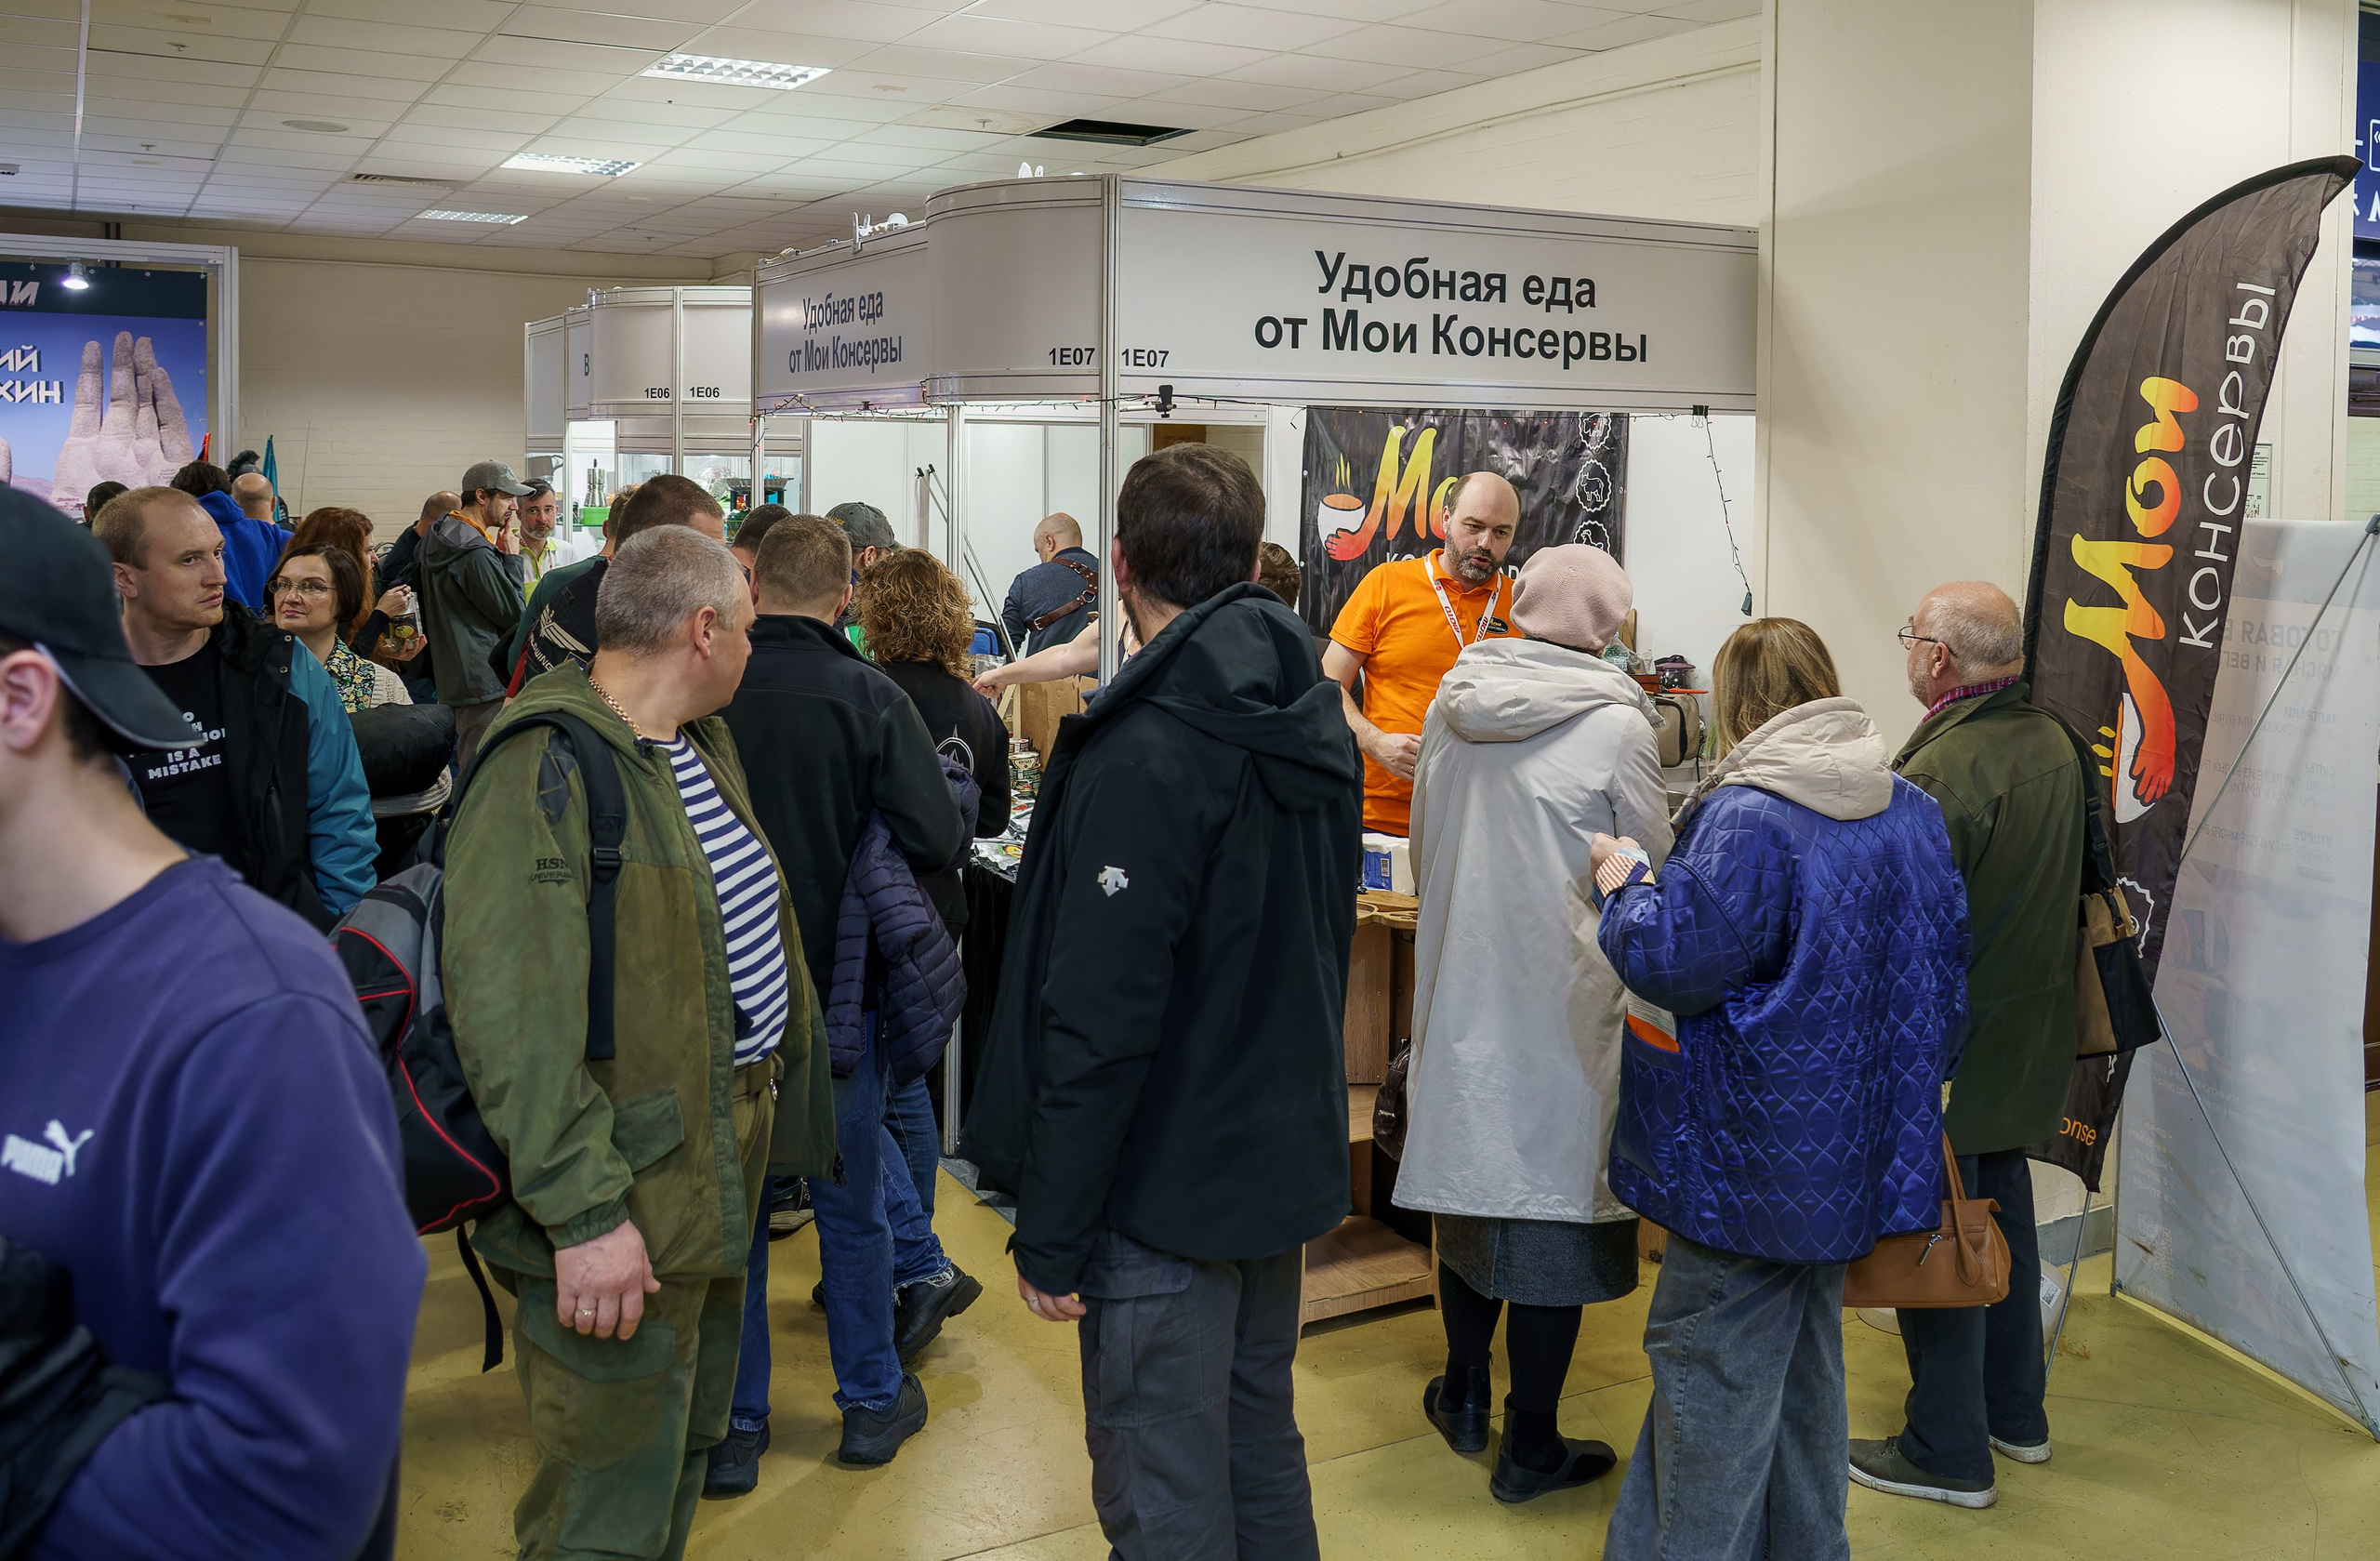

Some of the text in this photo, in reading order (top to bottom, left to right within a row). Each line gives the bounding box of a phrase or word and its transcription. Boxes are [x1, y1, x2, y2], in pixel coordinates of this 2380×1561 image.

[1314, 249, 1597, 314] Удобная еда
[802, 291, 883, 336] Удобная еда
[789, 335, 902, 375] от Мои Консервы
[1254, 307, 1647, 371] от Мои Консервы
[1049, 347, 1096, 366] 1E07
[1121, 348, 1170, 368] 1E07
[643, 387, 670, 400] 1E06
[689, 386, 721, 399] 1E06
[2178, 282, 2276, 649] консервы
[2063, 376, 2200, 671] Мои
[148, 754, 222, 779] MISTAKE
[167, 747, 201, 763] IS A
